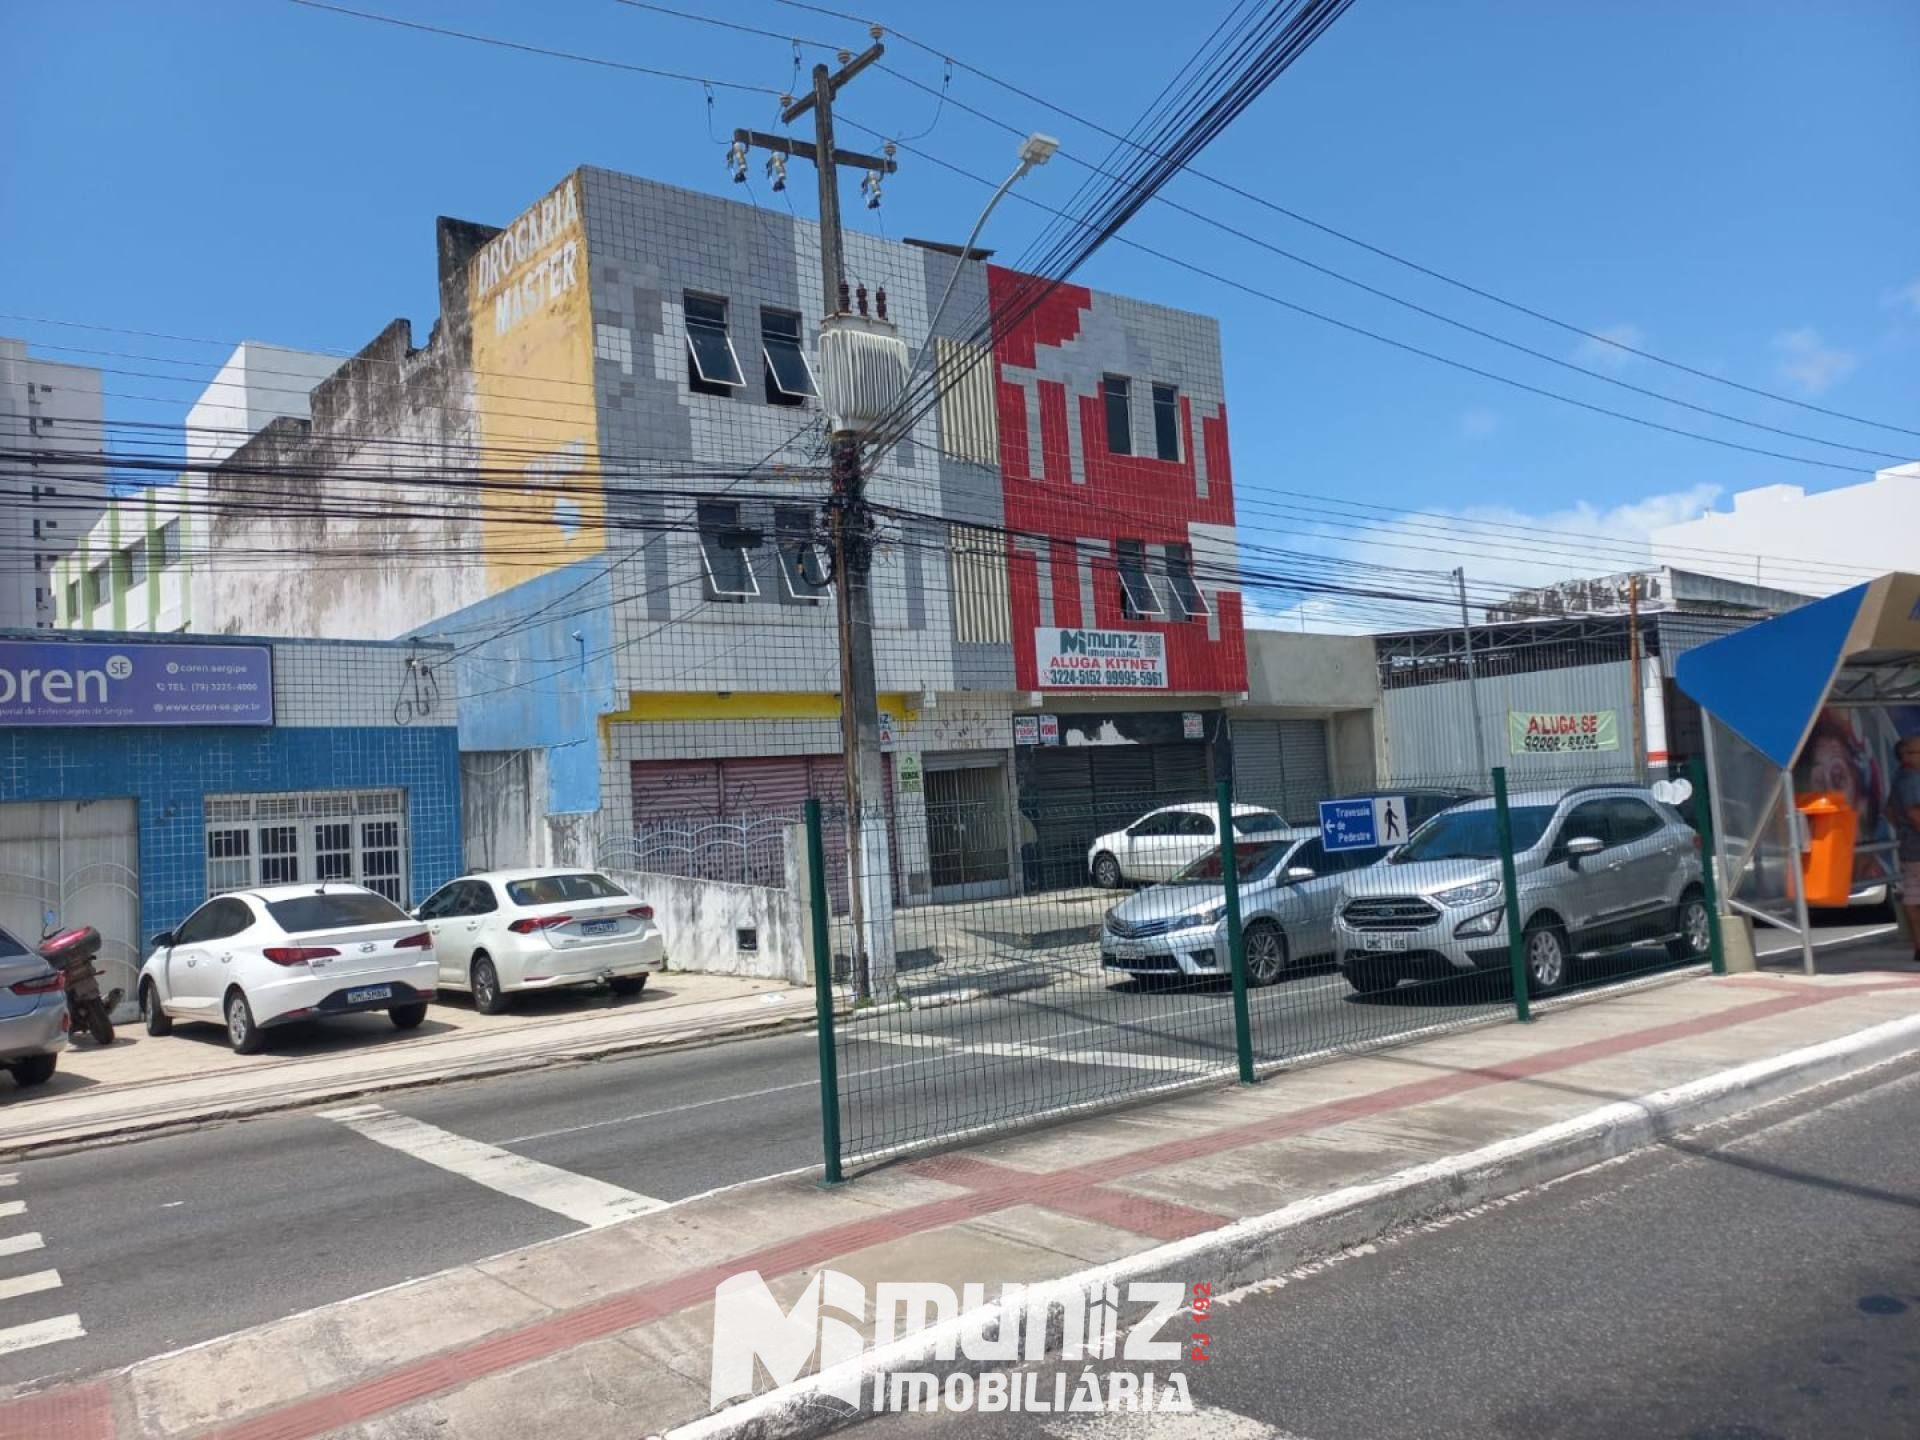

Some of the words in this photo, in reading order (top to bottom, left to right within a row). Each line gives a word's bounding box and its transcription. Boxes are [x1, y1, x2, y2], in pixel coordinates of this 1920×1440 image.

[111, 662, 128, 675] SE
[1050, 656, 1101, 669] ALUGA
[1105, 658, 1158, 670] KITNET
[1050, 669, 1101, 685] 3224-5152
